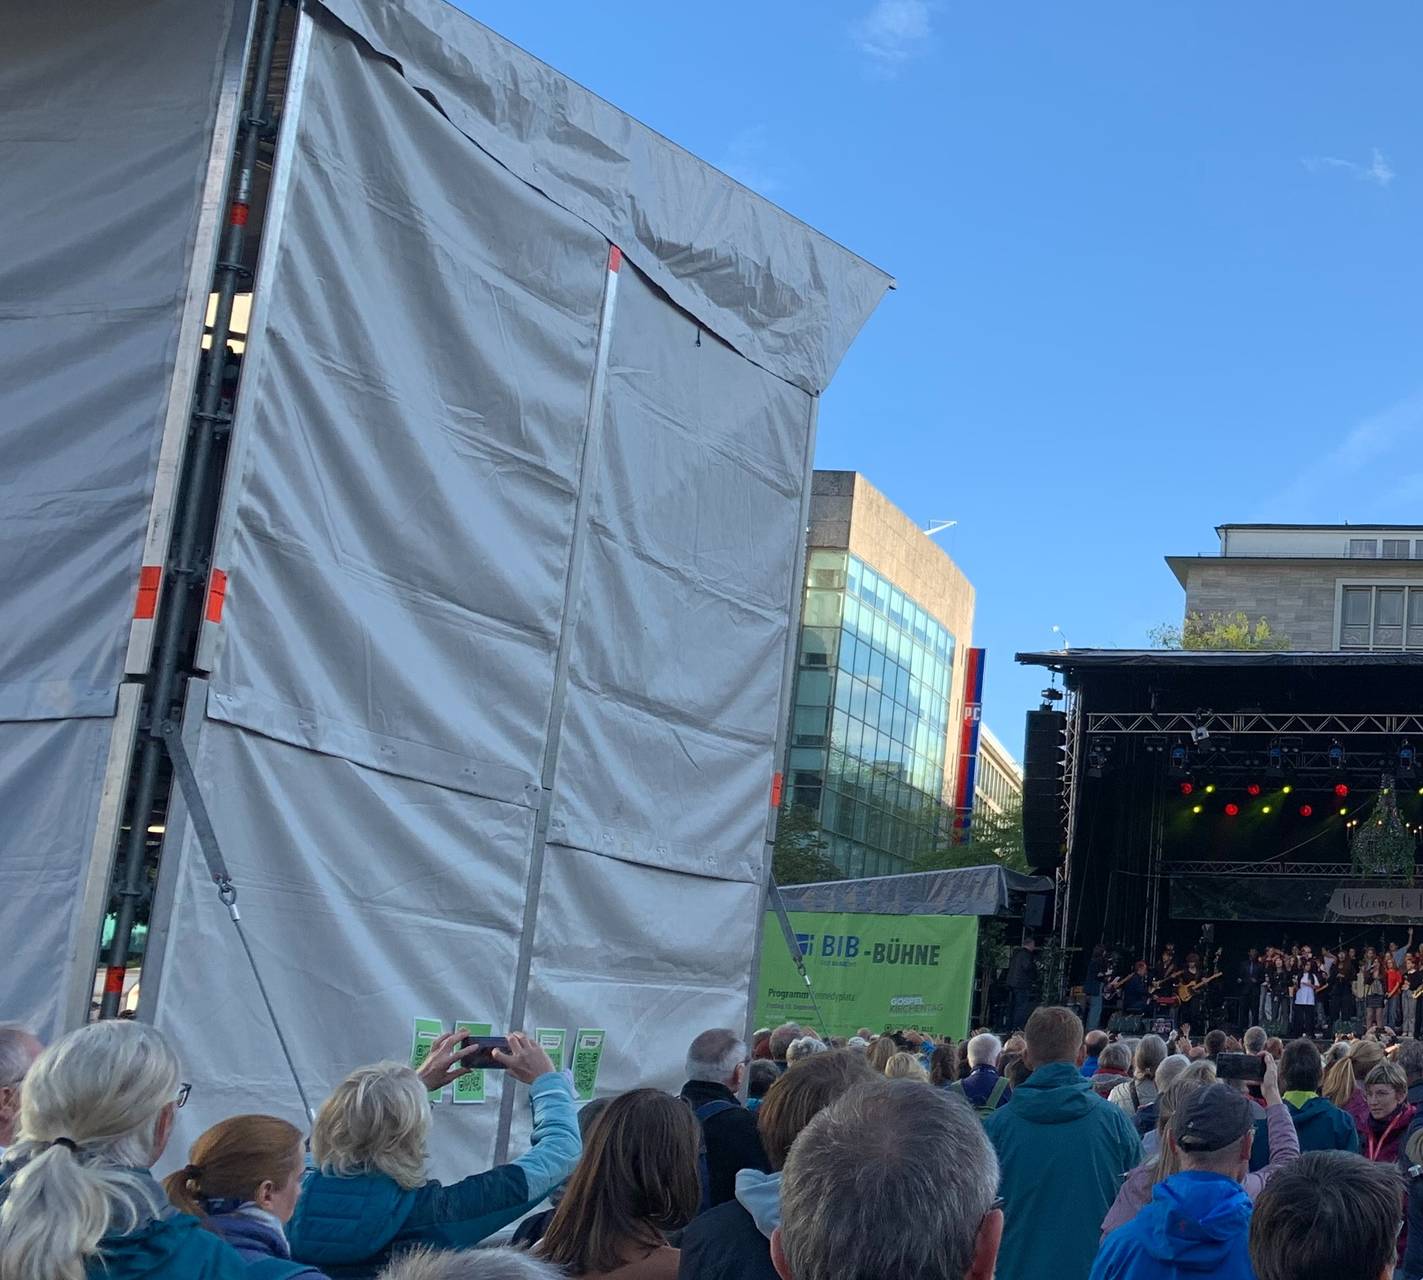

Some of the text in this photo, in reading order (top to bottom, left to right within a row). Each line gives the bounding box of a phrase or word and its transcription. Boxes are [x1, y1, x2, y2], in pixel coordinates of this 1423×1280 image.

[1342, 893, 1393, 910] Welcome
[1401, 895, 1413, 908] to
[821, 934, 941, 966] BIB -BÜHNE
[768, 988, 809, 1000] Programm
[890, 997, 923, 1006] GOSPEL
